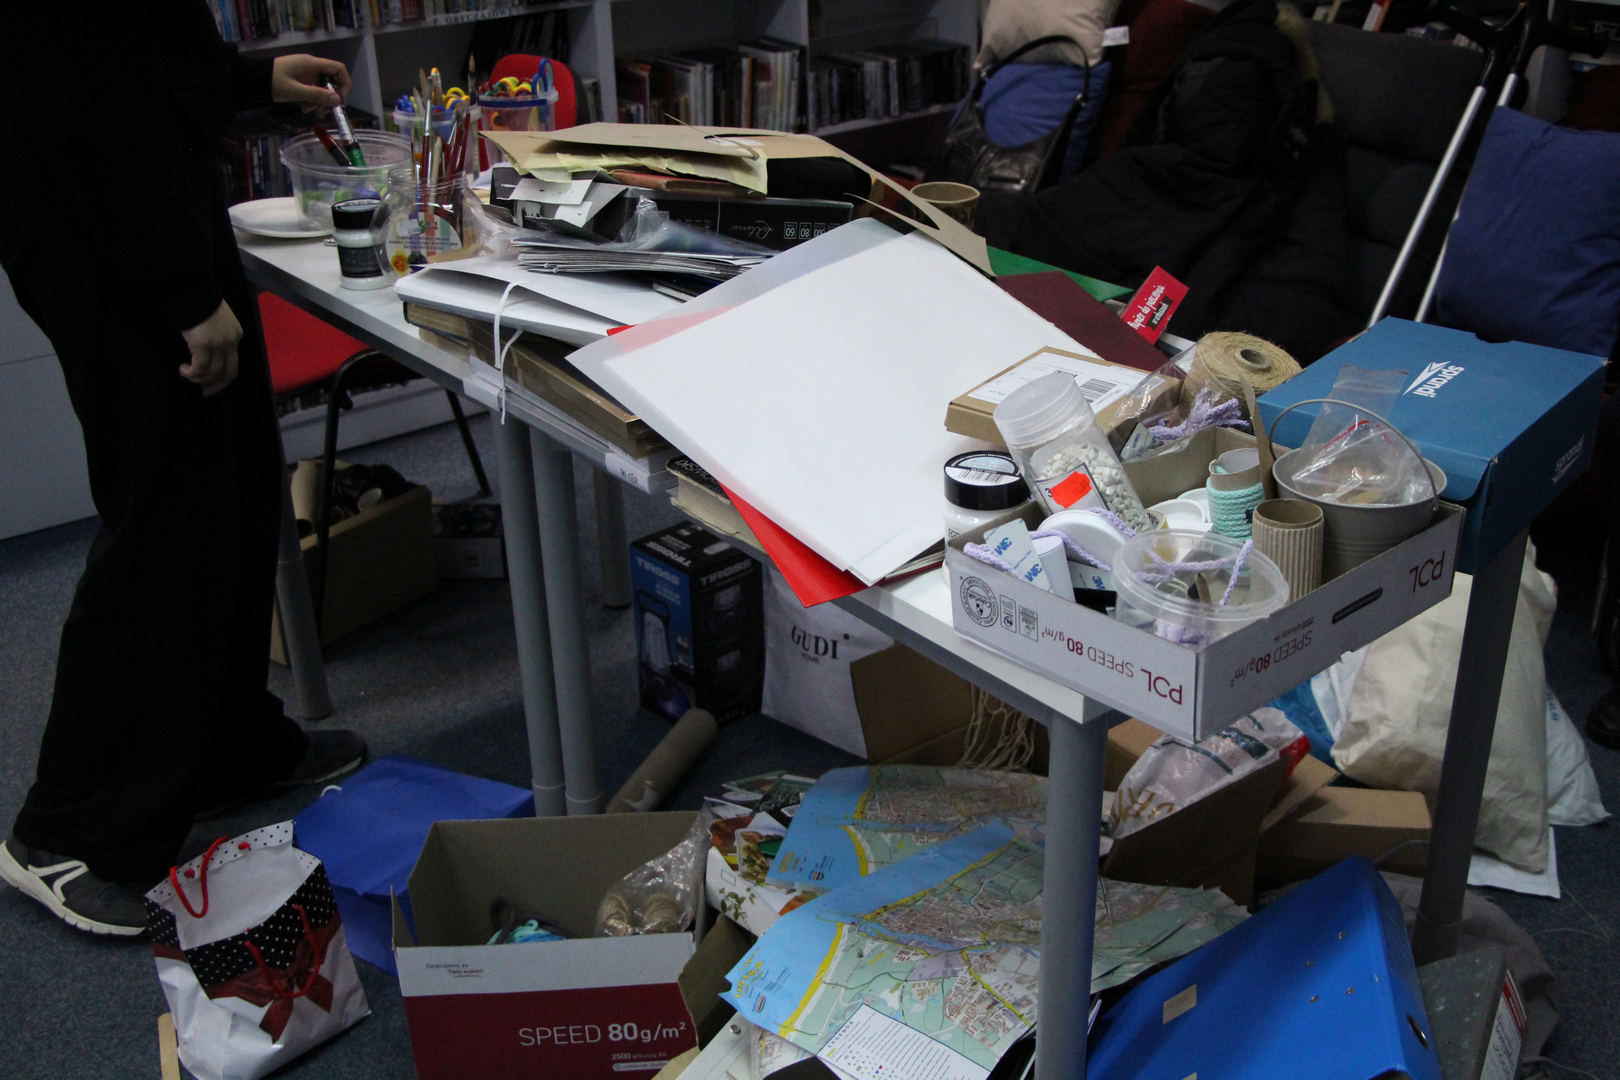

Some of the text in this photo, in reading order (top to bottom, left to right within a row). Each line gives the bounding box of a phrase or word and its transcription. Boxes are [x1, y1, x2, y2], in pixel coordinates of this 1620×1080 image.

[1412, 365, 1465, 398] sprandi
[994, 537, 1012, 556] 3M
[1024, 563, 1043, 582] 3M
[791, 625, 839, 660] GUDI
[1273, 630, 1313, 663] SPEED
[1087, 646, 1134, 678] SPEED
[734, 961, 765, 998] USTKA
[518, 1024, 602, 1046] SPEED
[827, 1020, 854, 1048] LEGENDA
[611, 1052, 631, 1061] 2500
